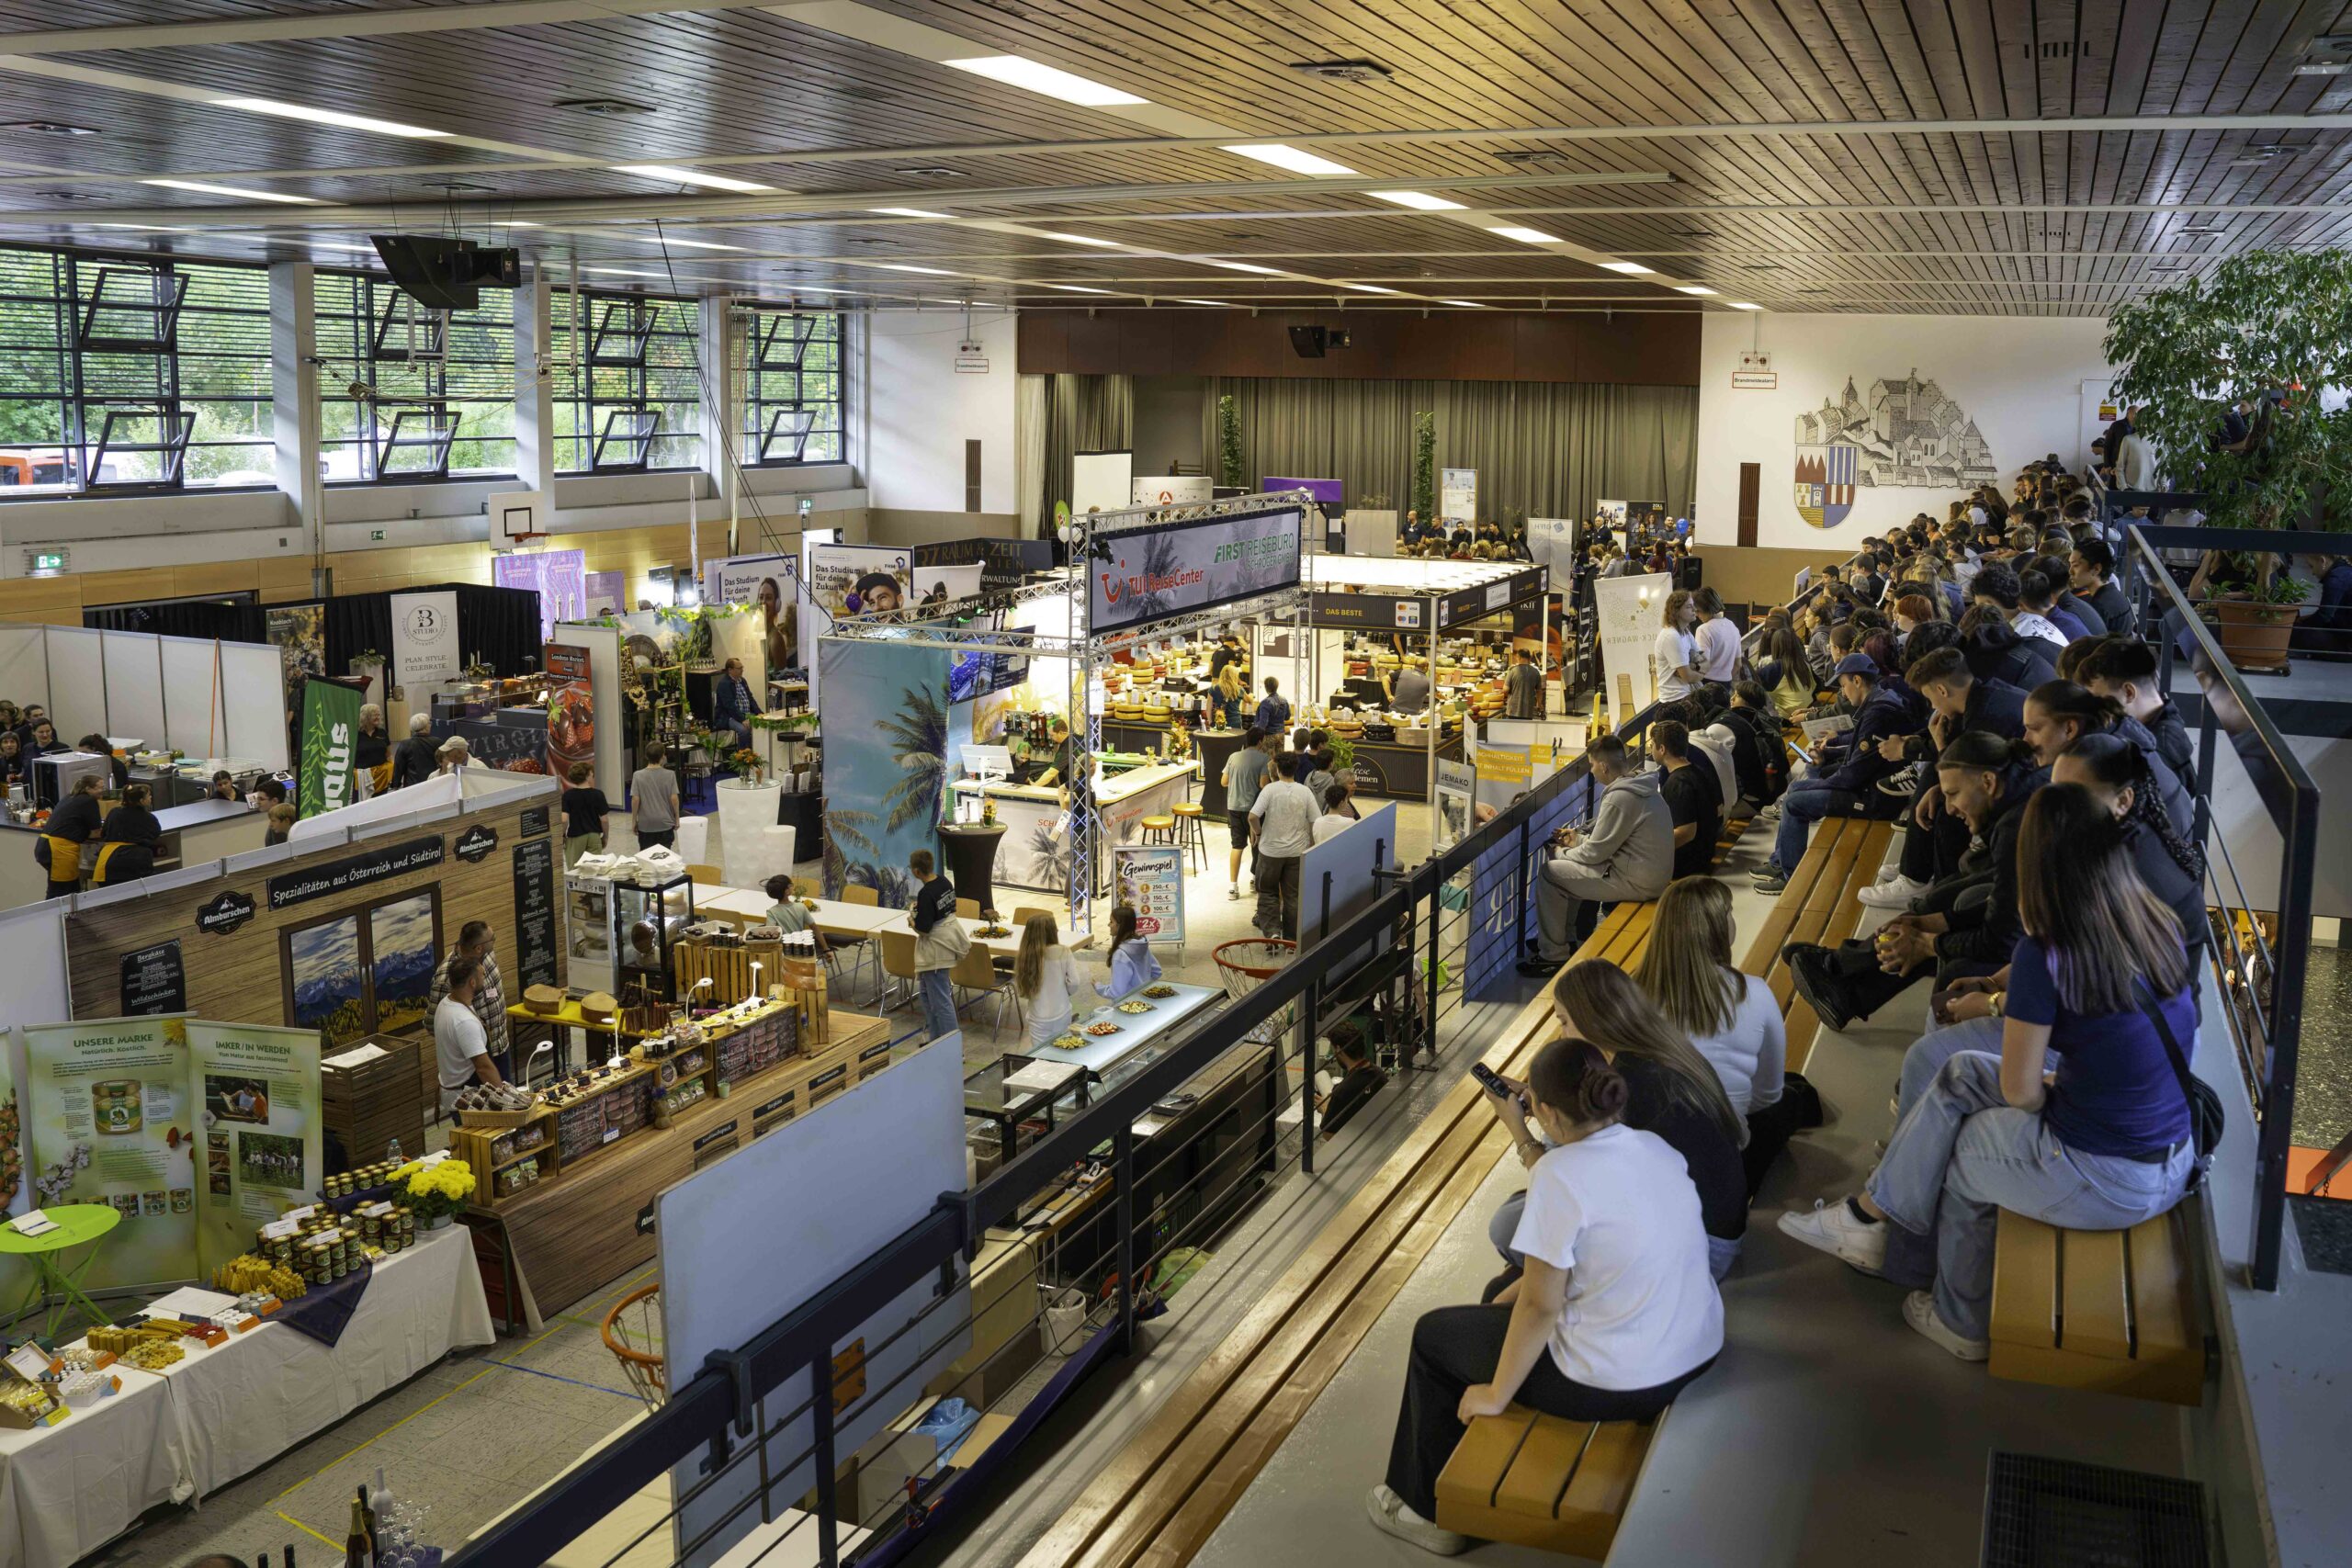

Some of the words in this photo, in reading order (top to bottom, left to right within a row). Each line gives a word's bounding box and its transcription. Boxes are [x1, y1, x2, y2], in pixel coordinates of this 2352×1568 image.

[942, 542, 974, 561] RAUM
[989, 542, 1024, 558] ZEIT
[1214, 541, 1245, 564] FIRST
[816, 565, 829, 573] Das
[831, 566, 861, 574] Studium
[725, 579, 735, 587] Das
[736, 576, 760, 584] Studium
[828, 574, 848, 582] deine
[1128, 574, 1147, 597] TUI
[1148, 569, 1204, 592] ReiseCenter
[725, 588, 734, 596] für
[816, 582, 844, 592] Zukunft
[417, 610, 434, 627] B
[1340, 609, 1363, 617] BESTE
[413, 627, 438, 636] STUDIO
[1476, 750, 1523, 761] ACHHALTIGKEIT
[1441, 773, 1469, 787] JEMAKO
[273, 880, 331, 905] Spezialitäten
[333, 874, 347, 886] aus
[349, 861, 391, 882] Österreich
[393, 855, 408, 868] und
[410, 846, 441, 865] Südtirol
[1124, 859, 1172, 879] Gewinnspiel
[204, 906, 250, 925] Almburschen
[131, 988, 177, 1004] Wildschinken
[74, 1036, 115, 1048] UNSERE
[118, 1033, 154, 1044] MARKE
[256, 1044, 291, 1055] WERDEN
